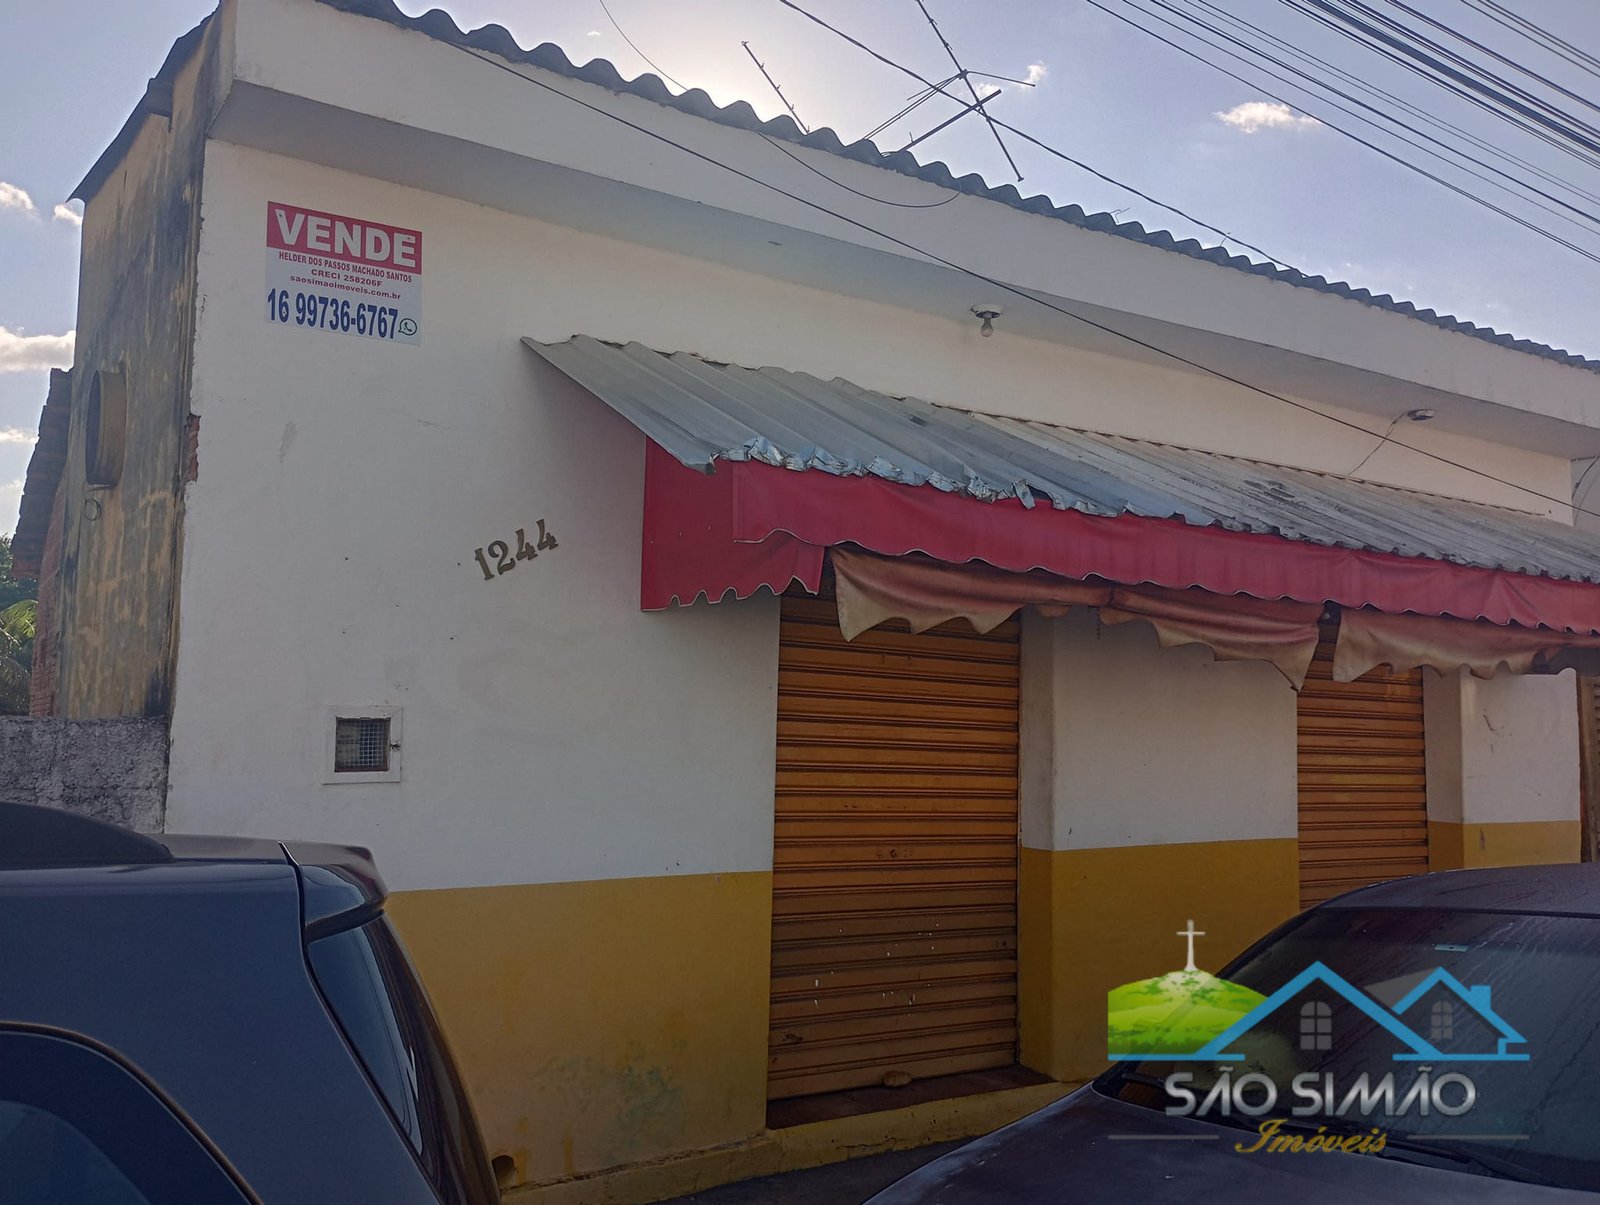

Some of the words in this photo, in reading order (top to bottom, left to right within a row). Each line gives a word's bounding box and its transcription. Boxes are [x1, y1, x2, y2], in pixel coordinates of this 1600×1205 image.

[275, 208, 416, 268] VENDE
[279, 251, 307, 264] HELDER
[309, 257, 323, 267] DOS
[324, 259, 350, 272] PASSOS
[352, 264, 385, 278] MACHADO
[386, 271, 412, 283] SANTOS
[290, 275, 401, 300] saosimaoimoveis.com.br
[311, 269, 341, 280] CRECI
[344, 274, 383, 287] 258206F
[268, 288, 289, 323] 16
[296, 292, 398, 339] 99736-6767
[475, 519, 558, 580] 1244
